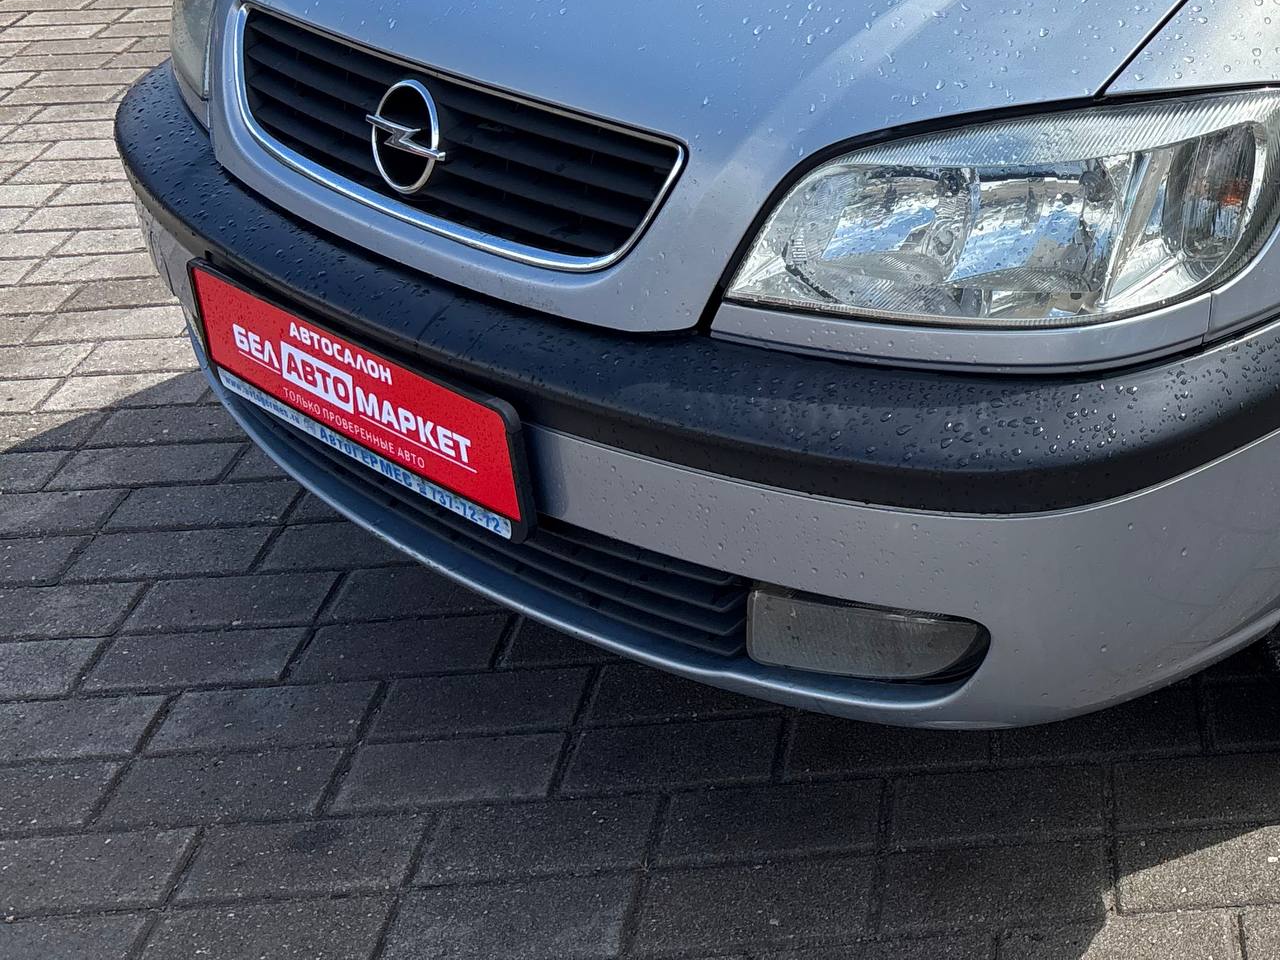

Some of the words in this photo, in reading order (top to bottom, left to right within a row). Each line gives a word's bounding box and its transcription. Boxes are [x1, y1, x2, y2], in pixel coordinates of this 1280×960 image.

[289, 322, 393, 386] АВТОСАЛОН
[283, 386, 321, 416] ТОЛЬКО
[323, 408, 395, 454] ПРОВЕРЕННЫЕ
[397, 447, 425, 469] АВТО
